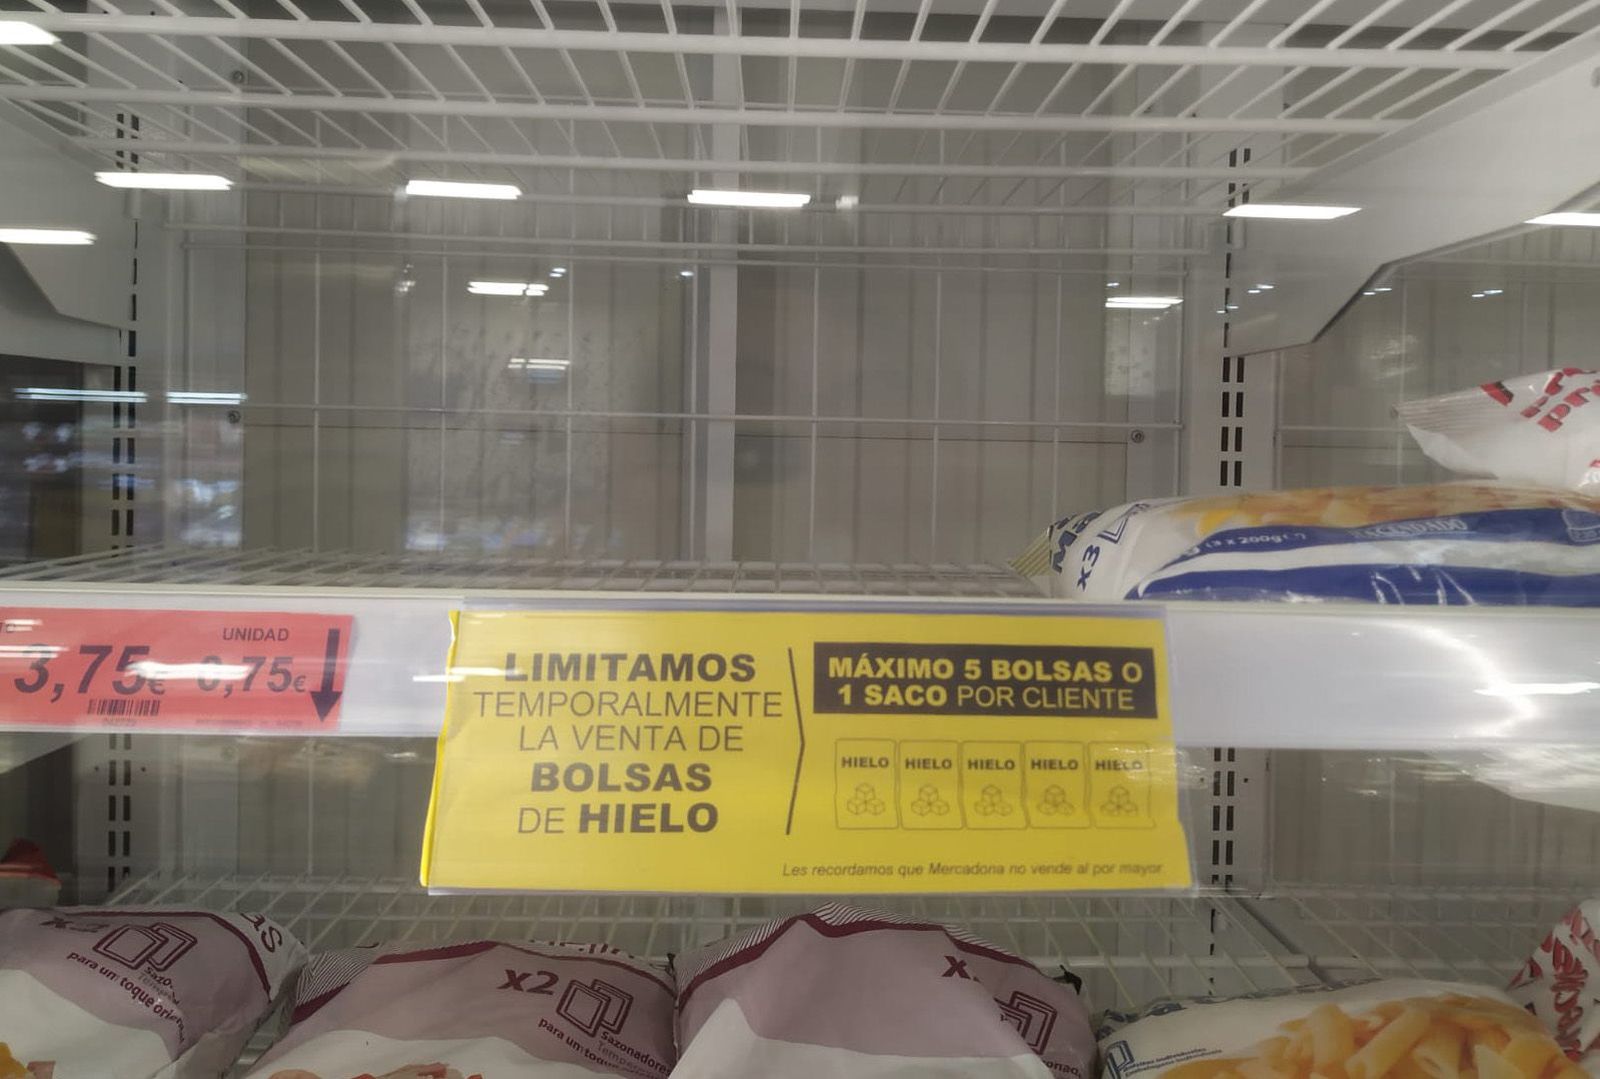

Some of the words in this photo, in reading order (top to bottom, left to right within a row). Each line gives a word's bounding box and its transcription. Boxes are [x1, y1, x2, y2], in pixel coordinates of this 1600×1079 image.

[1077, 544, 1100, 592] x3
[222, 627, 290, 642] UNIDAD
[504, 653, 757, 682] LIMITAMOS
[828, 652, 954, 680] MÁXIMO
[964, 658, 982, 681] 5
[991, 658, 1113, 683] BOLSAS
[1121, 662, 1143, 684] O
[473, 690, 783, 718] TEMPORALMENTE
[838, 685, 852, 705] 1
[864, 684, 948, 707] SACO
[957, 686, 1016, 708] POR
[1023, 687, 1136, 711] CLIENTE
[519, 726, 559, 751] LA
[573, 725, 688, 752] VENTA
[699, 726, 744, 752] DE
[841, 756, 889, 769] HIELO
[905, 757, 953, 770] HIELO
[967, 758, 1016, 771] HIELO
[1030, 758, 1079, 771] HIELO
[1095, 758, 1143, 772] HIELO
[531, 762, 713, 792] BOLSAS
[518, 807, 566, 834] DE
[578, 803, 719, 834] HIELO
[782, 863, 808, 877] Les
[812, 862, 893, 877] recordamos
[898, 865, 924, 879] que
[928, 862, 1005, 876] Mercadona
[1009, 864, 1027, 876] no
[1030, 862, 1072, 875] vende
[1076, 861, 1089, 875] al
[1092, 864, 1115, 879] por
[1119, 864, 1163, 879] mayor
[67, 952, 99, 970] para
[120, 977, 155, 1008] toque
[497, 969, 559, 995] x2
[538, 1019, 565, 1040] para
